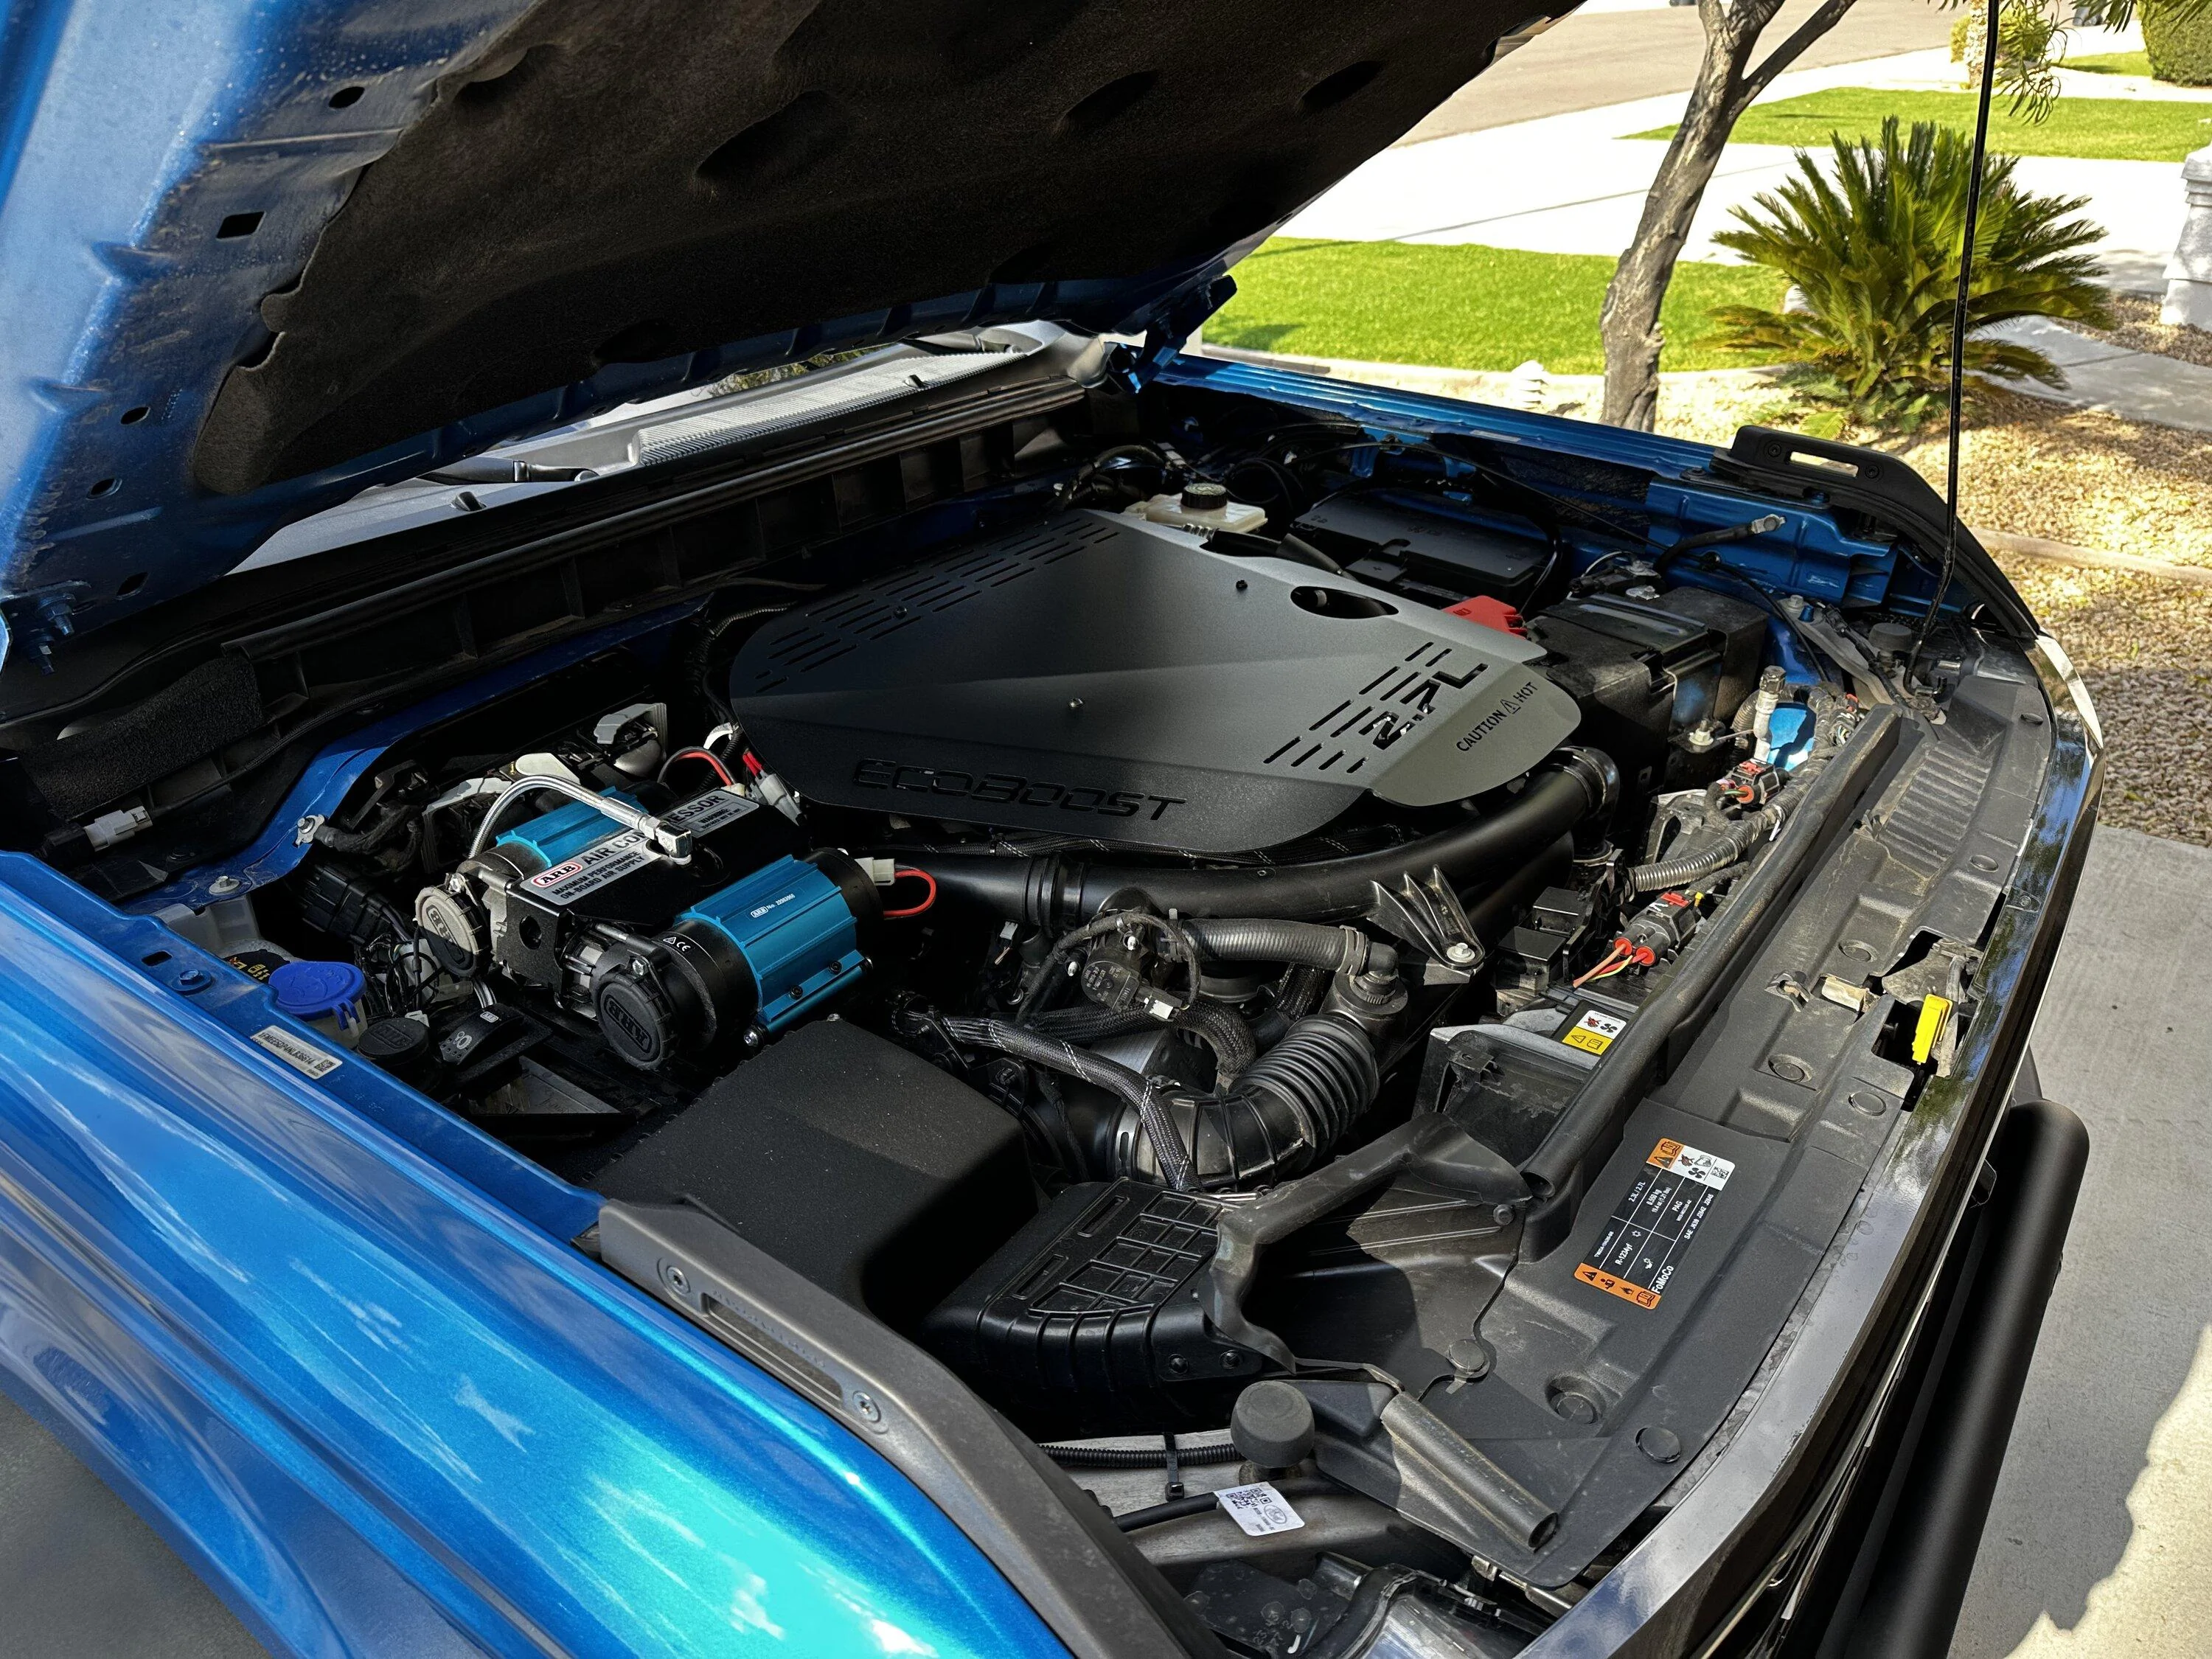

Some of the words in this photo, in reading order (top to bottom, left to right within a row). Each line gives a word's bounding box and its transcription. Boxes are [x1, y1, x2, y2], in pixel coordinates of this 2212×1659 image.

[1456, 709, 1507, 752] CAUTION
[1513, 681, 1538, 703] HOT
[852, 757, 1187, 821] ECOBOOST
[540, 865, 576, 883] ARB
[581, 847, 615, 866] AIR
[552, 875, 590, 896] MAXIMUM
[588, 850, 640, 878] PERFORMANCE
[560, 877, 602, 899] ON-BOARD
[601, 871, 615, 880] AIR
[615, 855, 645, 872] SUPPLY
[609, 1001, 648, 1046] ARB
[1672, 1200, 1683, 1211] PAG
[1615, 1242, 1633, 1265] R-1234yf
[1683, 1228, 1694, 1239] SAE
[1651, 1265, 1674, 1294] FoMoCo
